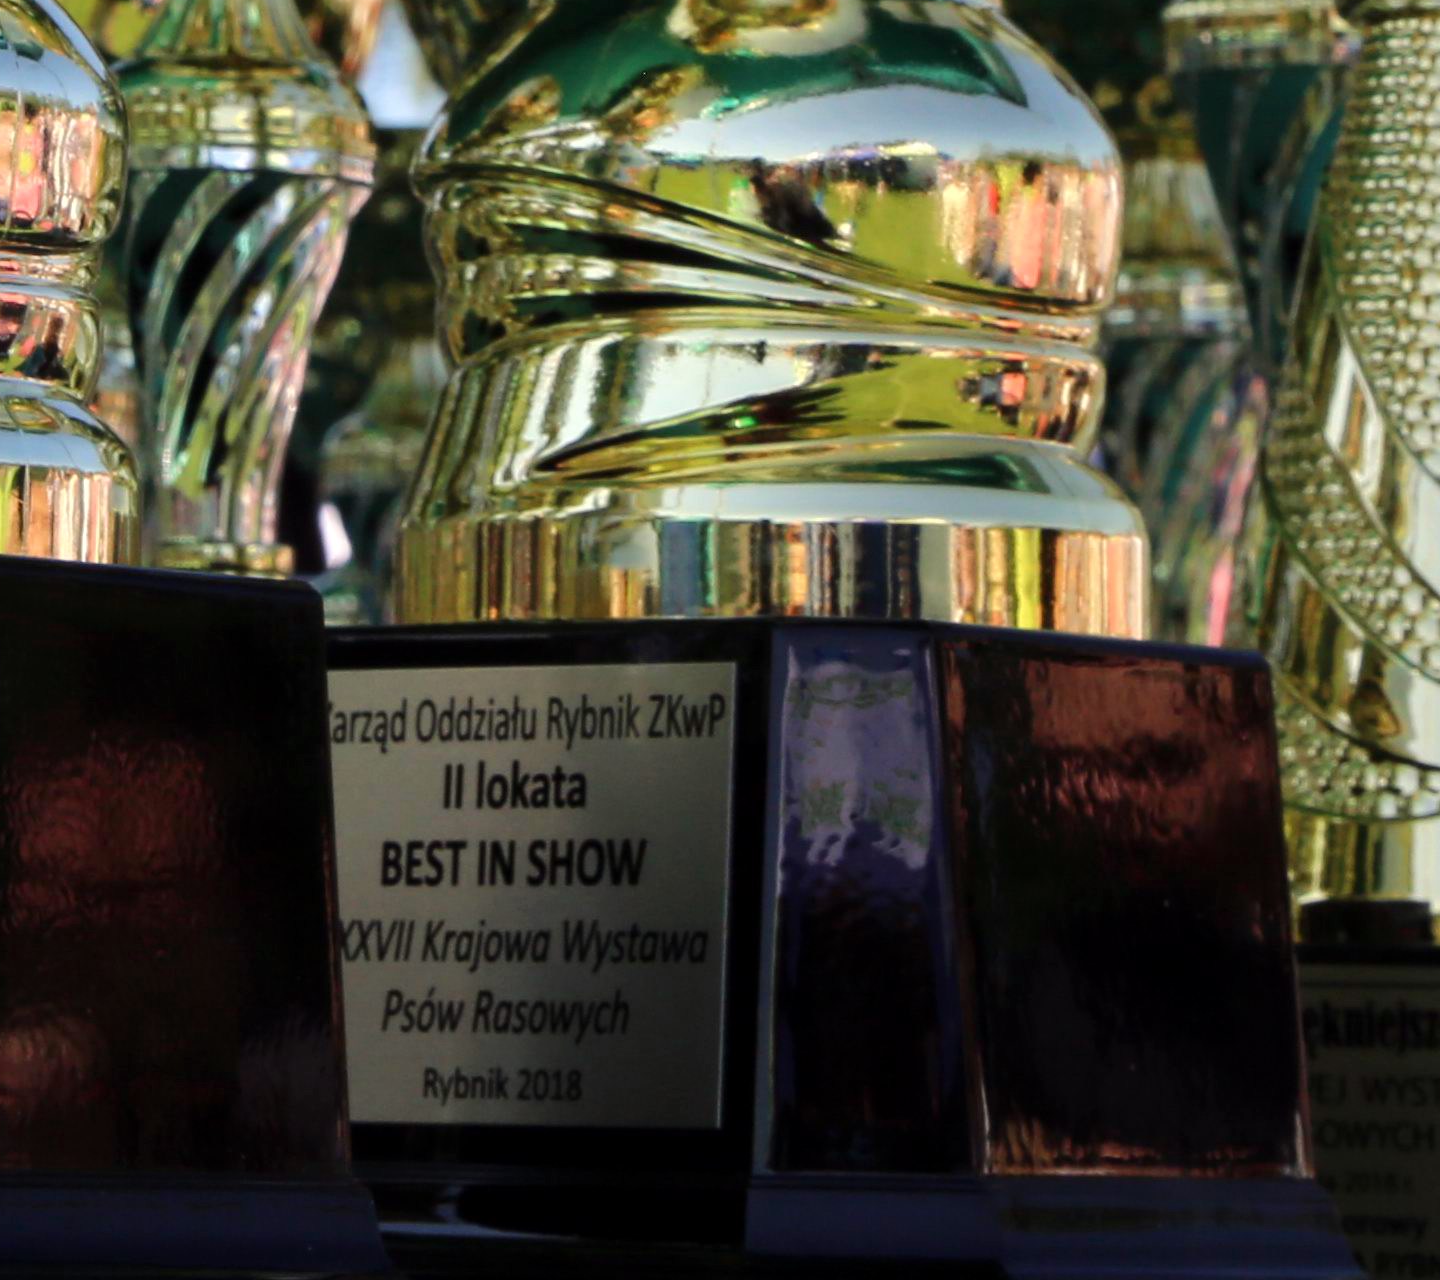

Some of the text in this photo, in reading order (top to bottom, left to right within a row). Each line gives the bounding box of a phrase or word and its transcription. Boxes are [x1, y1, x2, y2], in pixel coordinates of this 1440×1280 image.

[415, 696, 537, 743] Oddziału
[547, 694, 640, 751] Rybnik
[647, 693, 728, 739] ZKwP
[443, 759, 587, 810] II lokata
[381, 838, 648, 887] BEST IN SHOW
[339, 919, 709, 974] XXVII Krajowa Wystawa
[382, 987, 630, 1046] Psów Rasowych
[423, 1067, 582, 1106] Rybnik 2018
[1315, 1118, 1436, 1152] OWYCH
